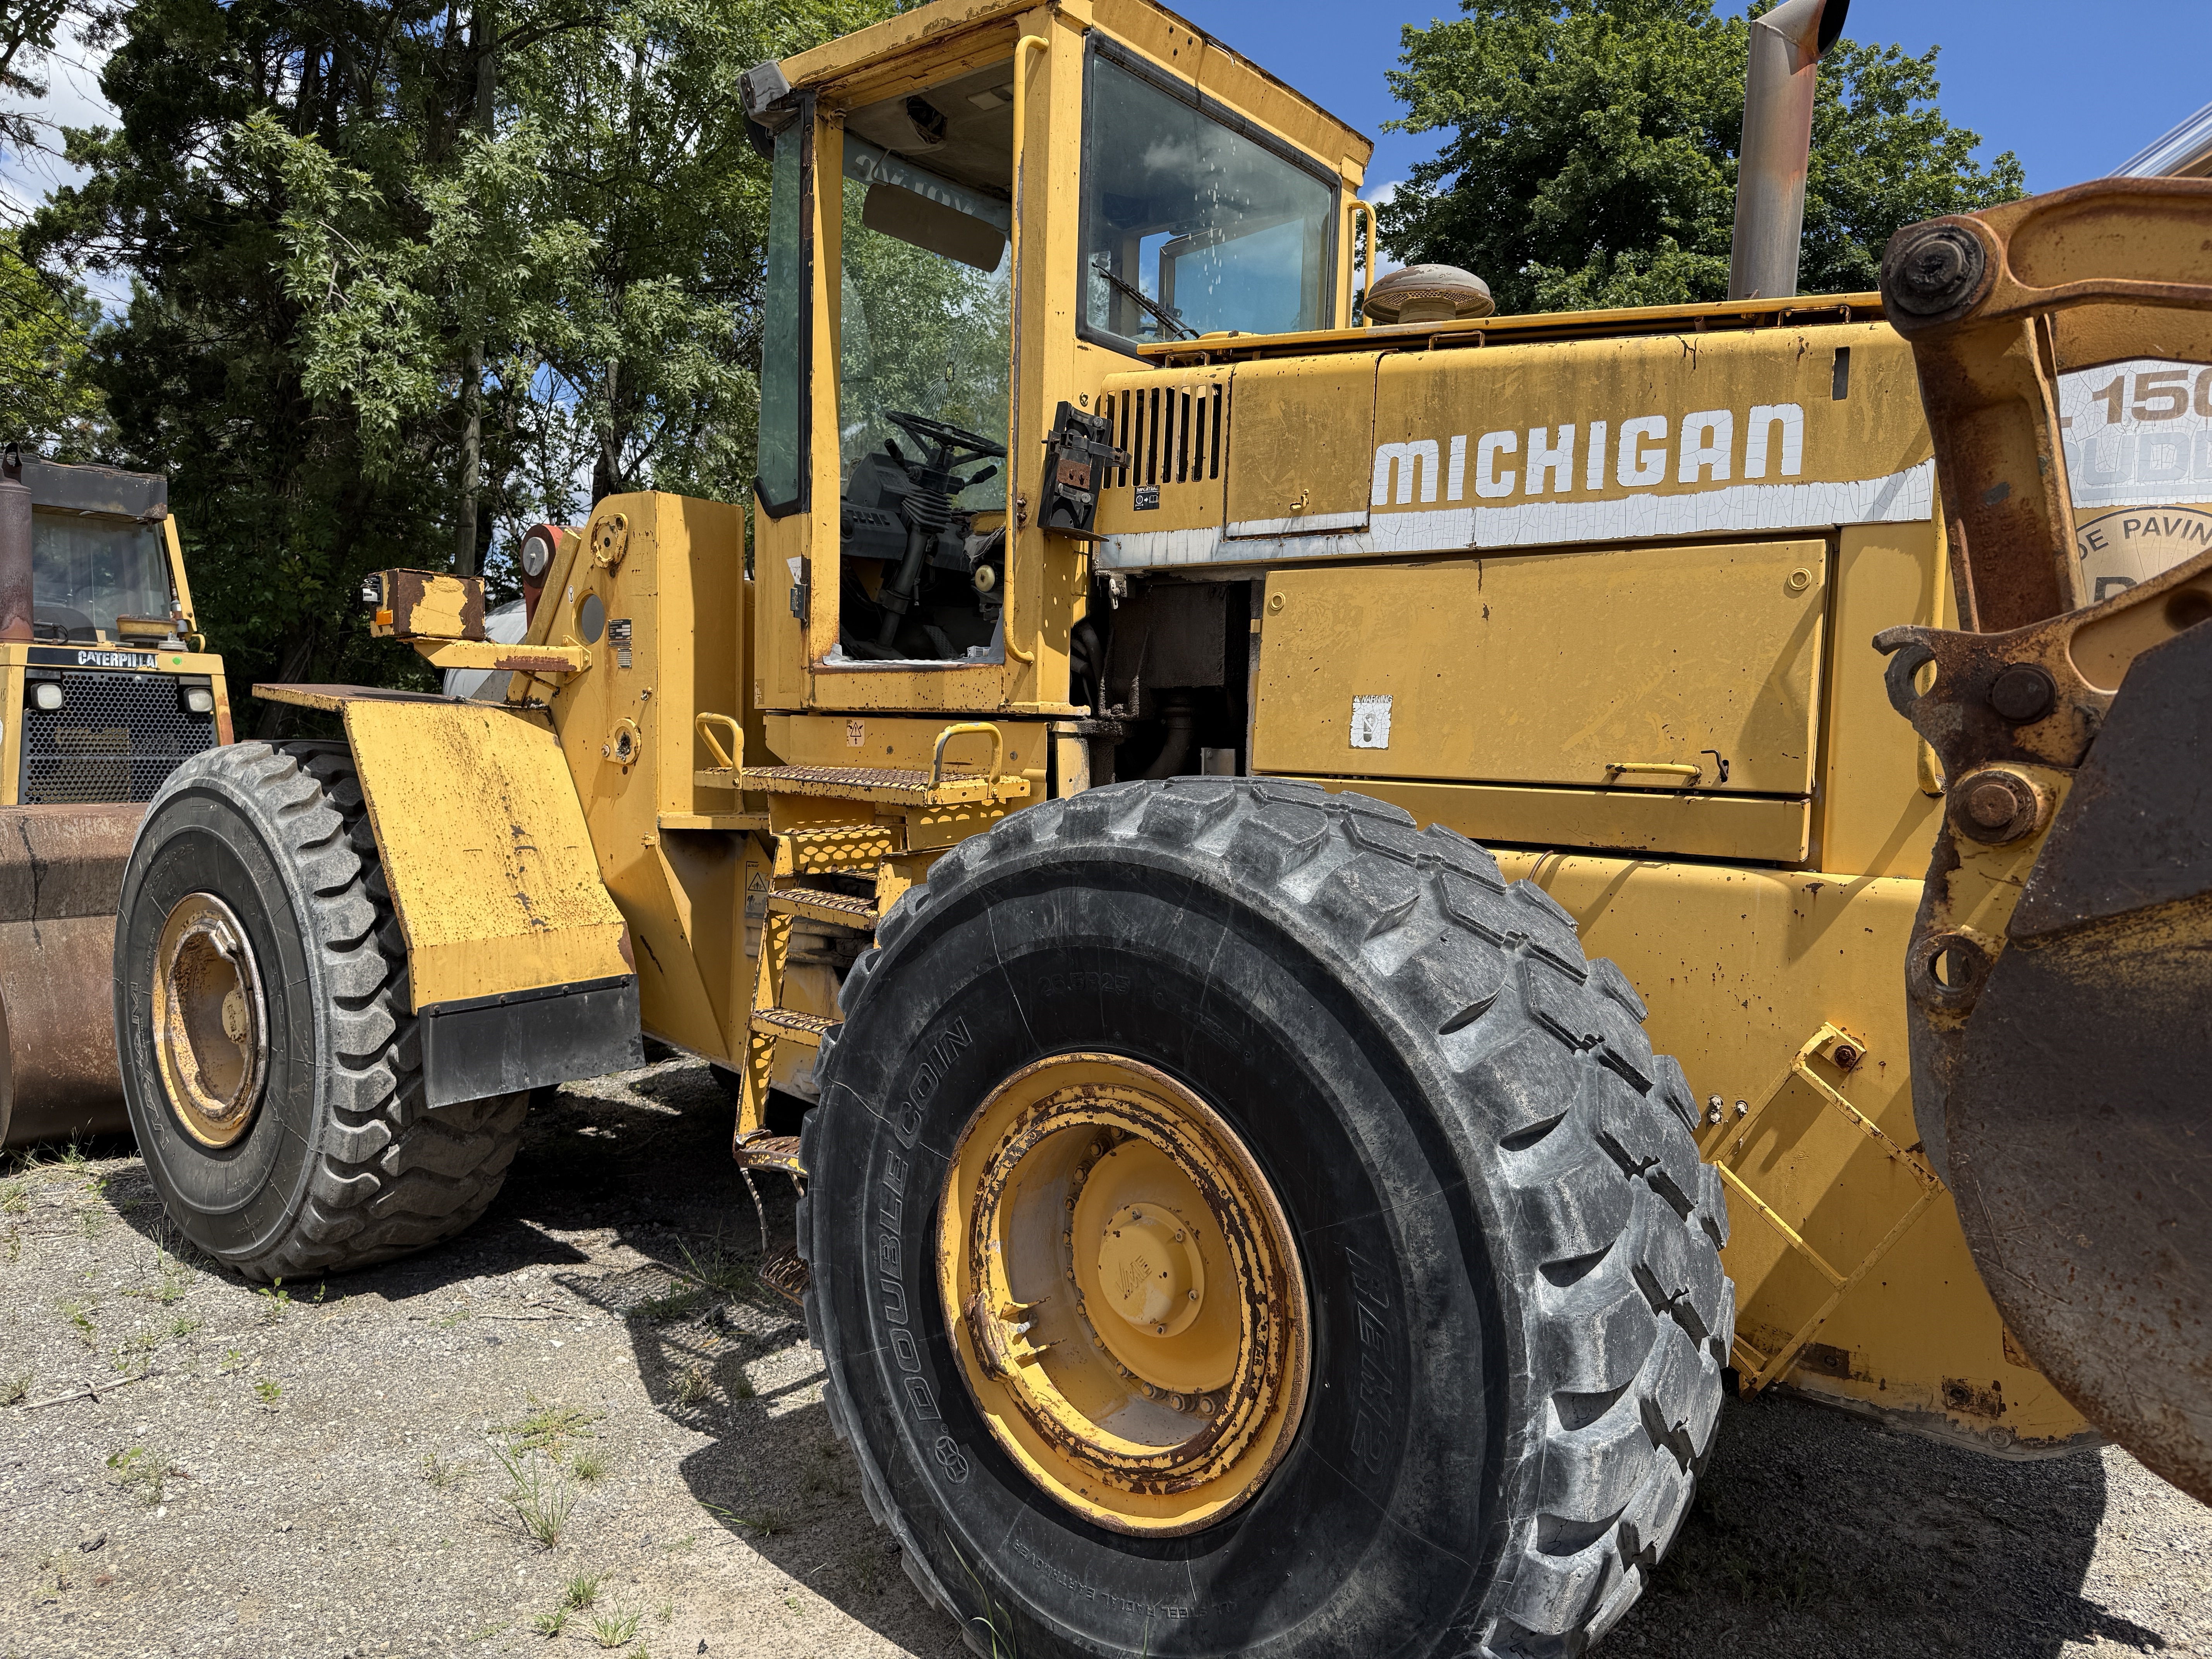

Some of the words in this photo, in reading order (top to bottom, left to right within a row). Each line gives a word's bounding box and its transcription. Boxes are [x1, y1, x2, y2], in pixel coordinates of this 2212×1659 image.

[1371, 403, 1804, 506] MICHIGAN
[1038, 972, 1130, 996] 26.5R25
[894, 1016, 972, 1150] COIN
[879, 1150, 941, 1421] DOUBLE
[1115, 1255, 1152, 1298] VME
[1013, 1539, 1096, 1601] EARTHMOVER
[1101, 1592, 1156, 1617] RADIAL
[1162, 1606, 1208, 1619] STEEL
